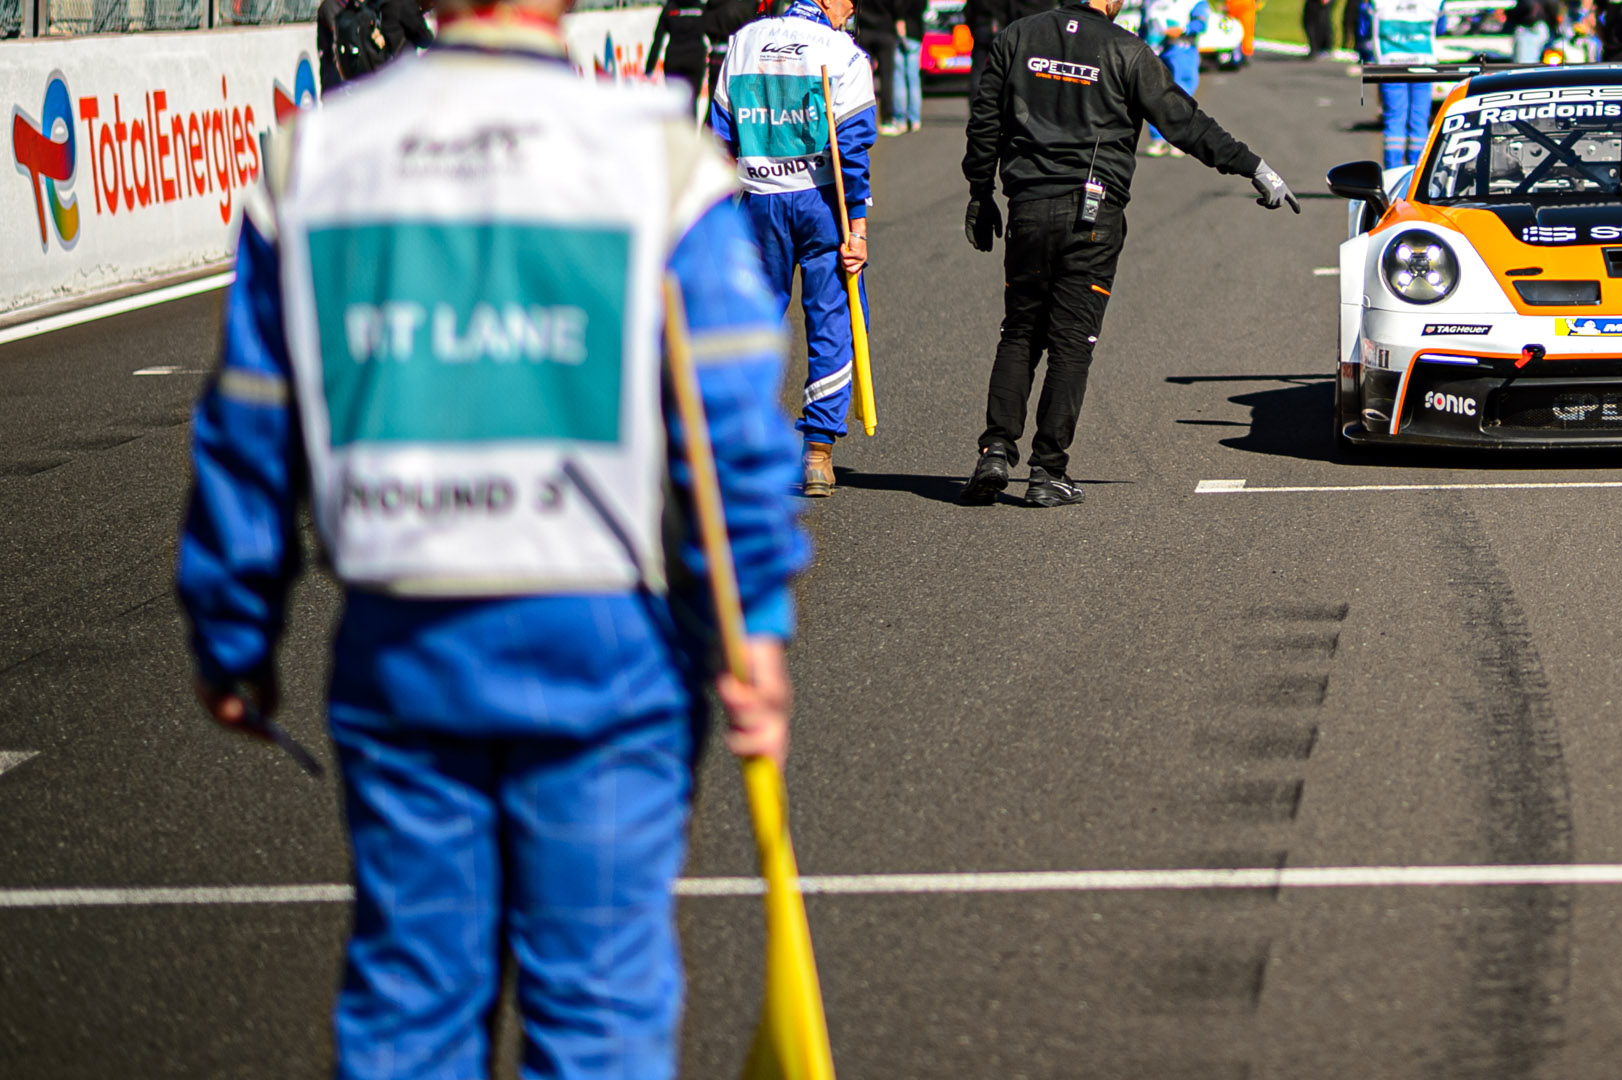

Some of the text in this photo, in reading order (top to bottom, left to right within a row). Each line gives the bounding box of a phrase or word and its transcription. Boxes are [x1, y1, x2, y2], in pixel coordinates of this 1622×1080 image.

[761, 42, 809, 55] WEC
[738, 106, 819, 126] PIT LANE
[1442, 101, 1621, 134] D. Raudonis
[79, 74, 259, 226] TotalEnergies
[1442, 128, 1485, 165] 5
[747, 159, 809, 179] ROUND
[432, 301, 589, 366] LANE
